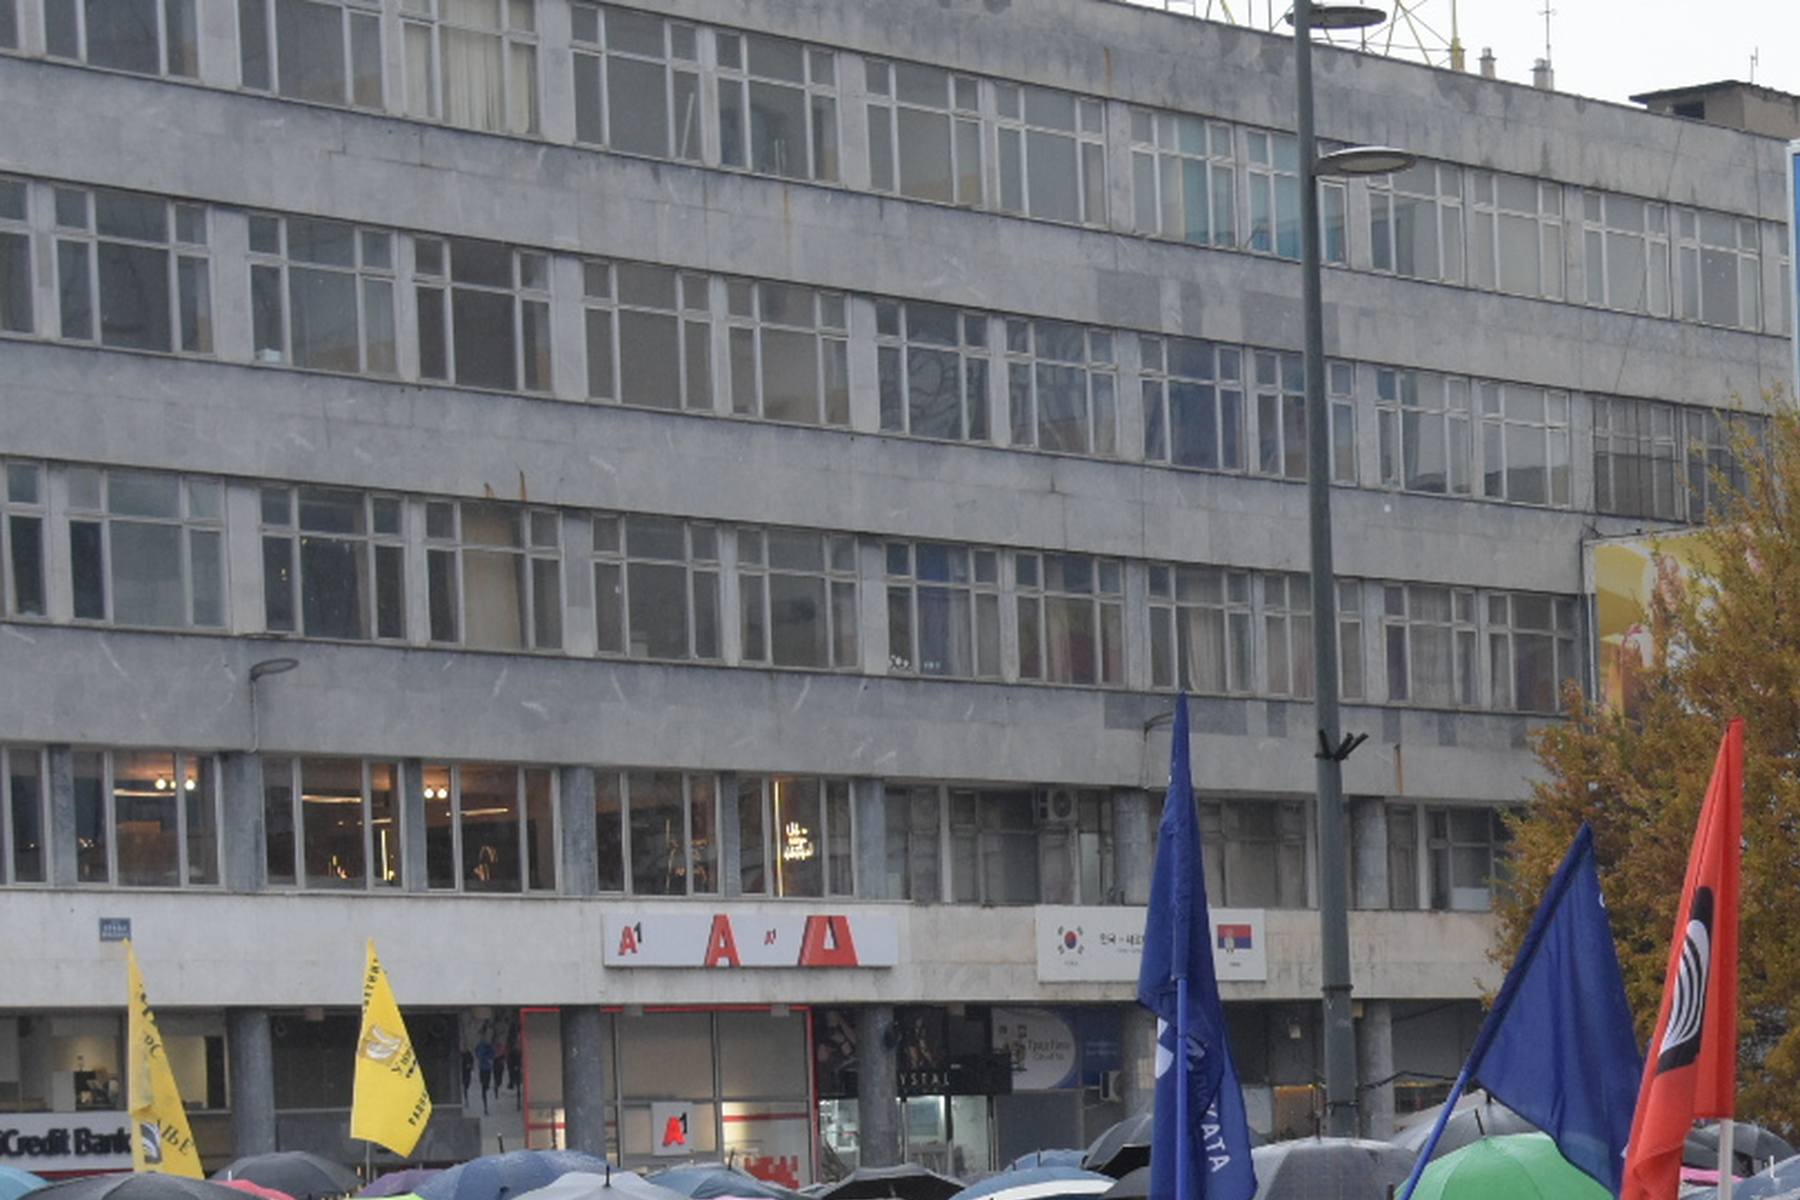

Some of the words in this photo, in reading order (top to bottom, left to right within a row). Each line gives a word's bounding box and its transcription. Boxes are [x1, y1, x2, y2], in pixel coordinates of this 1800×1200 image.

[618, 922, 642, 956] A1
[900, 1072, 950, 1087] YSTAL
[0, 1128, 71, 1156] Credit
[73, 1127, 132, 1155] Bank
[662, 1112, 687, 1146] A1
